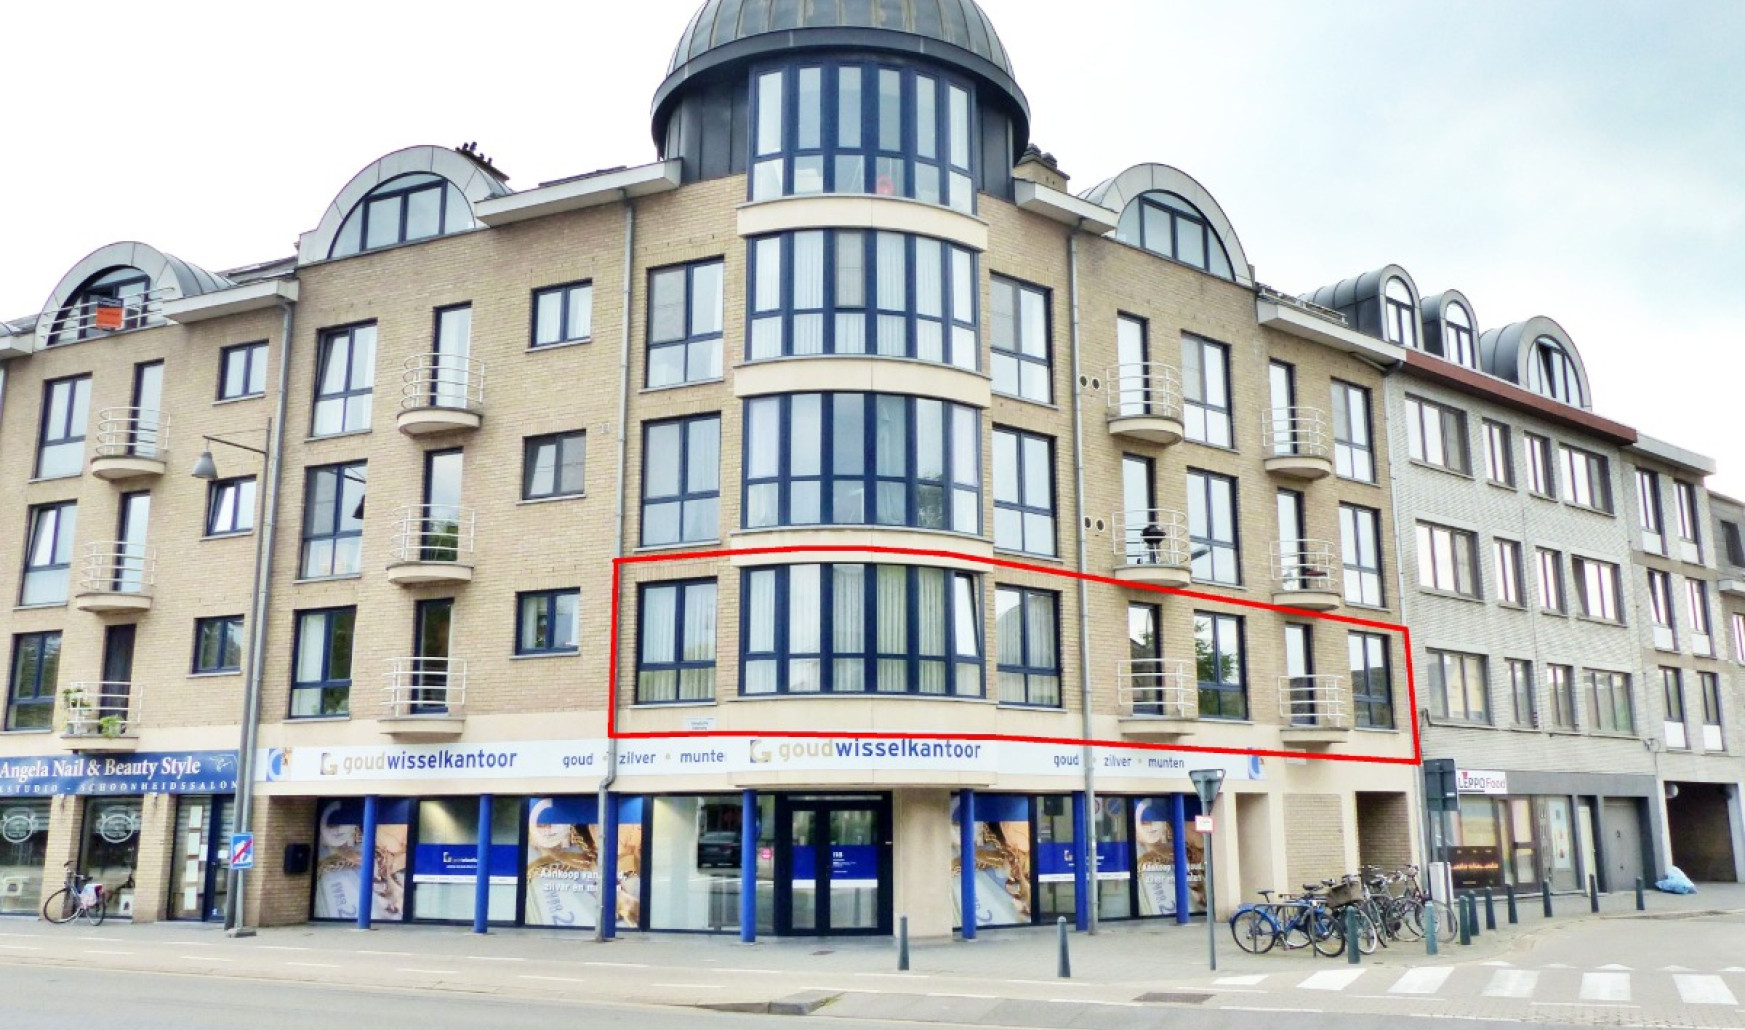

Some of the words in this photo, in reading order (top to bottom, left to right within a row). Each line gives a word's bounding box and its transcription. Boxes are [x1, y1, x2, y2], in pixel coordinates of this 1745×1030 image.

[343, 749, 517, 774] goudwisselkantoor
[562, 753, 594, 768] goud
[619, 751, 657, 765] zilver
[778, 738, 980, 762] goudwisselkantoor
[1053, 753, 1080, 768] goud
[1103, 754, 1132, 767] zilver
[1148, 757, 1185, 769] munten
[0, 760, 49, 783] Angela
[52, 758, 85, 777] Nail
[86, 758, 102, 776] &
[104, 757, 158, 780] Beauty
[161, 755, 201, 780] Style
